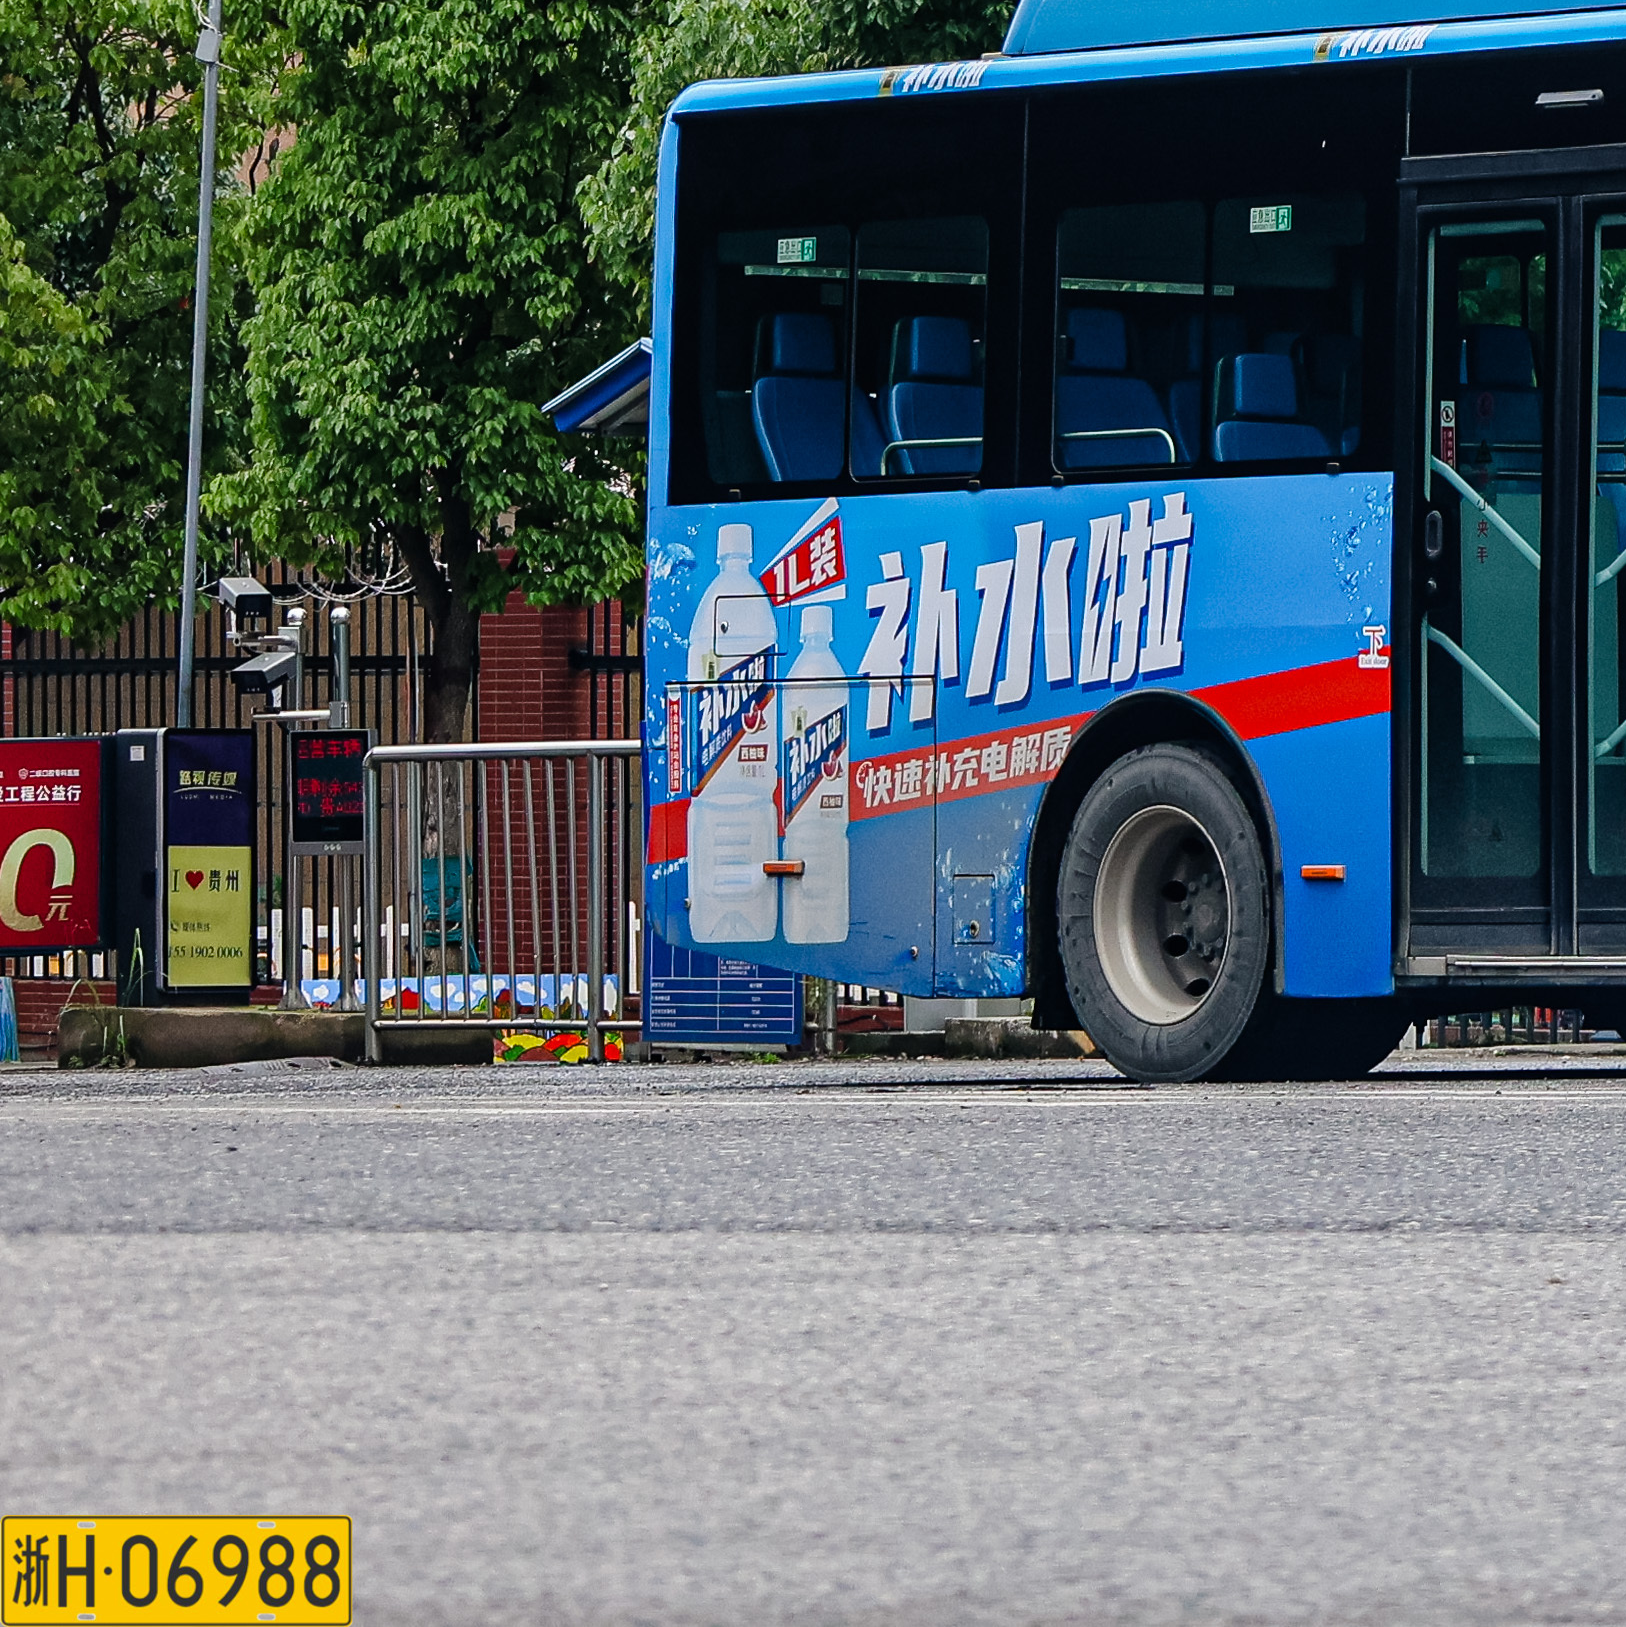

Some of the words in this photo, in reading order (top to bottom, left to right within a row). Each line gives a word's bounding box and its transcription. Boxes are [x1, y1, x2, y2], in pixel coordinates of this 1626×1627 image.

[774, 526, 838, 603] 1L装
[861, 491, 1193, 731] 补水啦
[863, 726, 1073, 809] 快速补充电解质
[208, 869, 240, 892] 贵州
